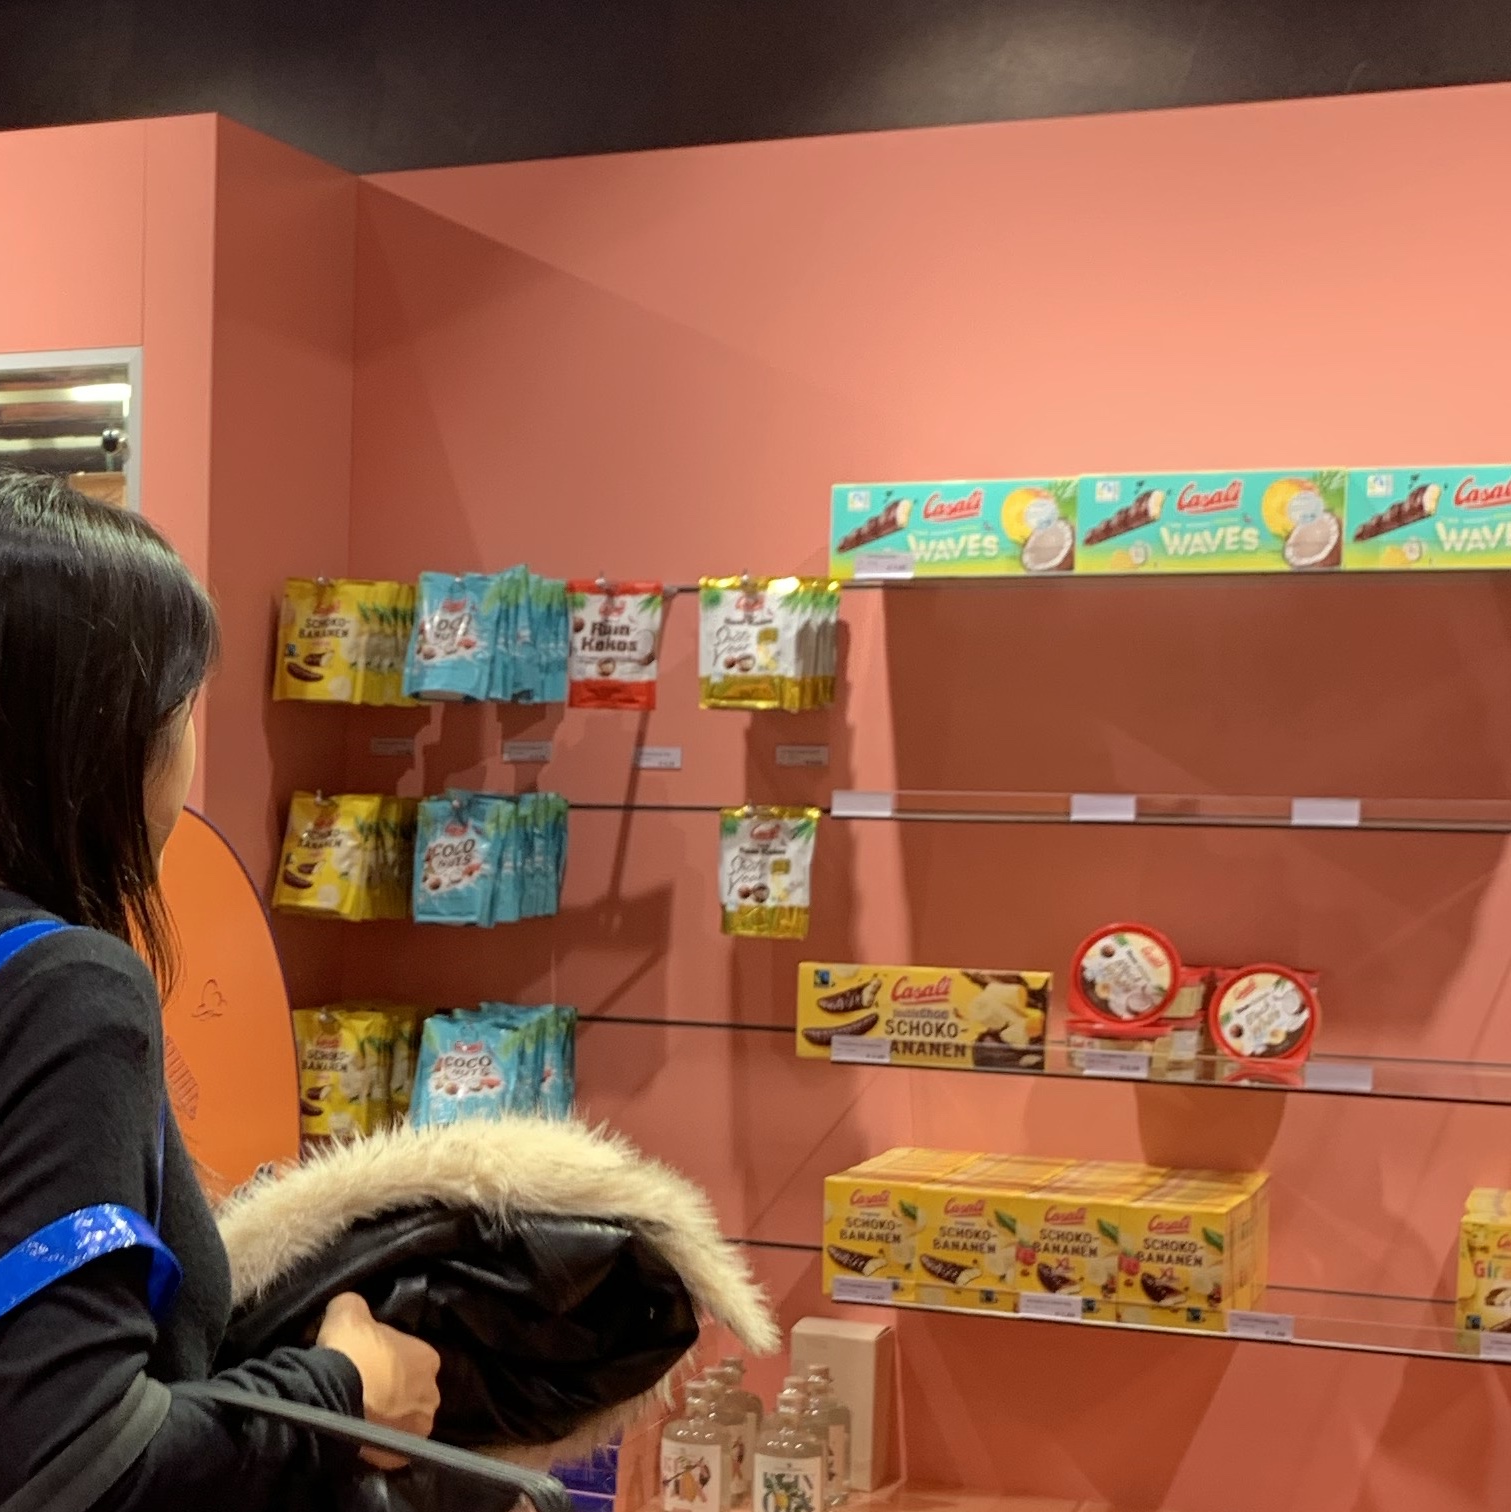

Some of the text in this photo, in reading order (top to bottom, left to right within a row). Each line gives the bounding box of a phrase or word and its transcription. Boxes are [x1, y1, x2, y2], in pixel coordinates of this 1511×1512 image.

[1177, 480, 1242, 513] Casali
[1454, 476, 1511, 509] Casa
[922, 488, 984, 522] Casali
[1160, 526, 1259, 556] WAVES
[1435, 520, 1511, 553] WAV
[907, 533, 1000, 562] WAVES
[891, 975, 952, 1006] Casali
[884, 1019, 969, 1038] SCHOKO-
[888, 1040, 967, 1058] ANANEN
[444, 1055, 492, 1068] COCO
[845, 1216, 902, 1230] SCHOKO-
[1147, 1214, 1191, 1234] Casali
[840, 1229, 901, 1244] BANANEN
[939, 1226, 998, 1240] SCHOKO-
[1039, 1228, 1100, 1244] SCHOKO-
[933, 1239, 996, 1254] BANANEN
[1033, 1241, 1099, 1258] BANANEN
[1142, 1237, 1204, 1252] SCHOKO-
[1137, 1251, 1203, 1268] BANANEN
